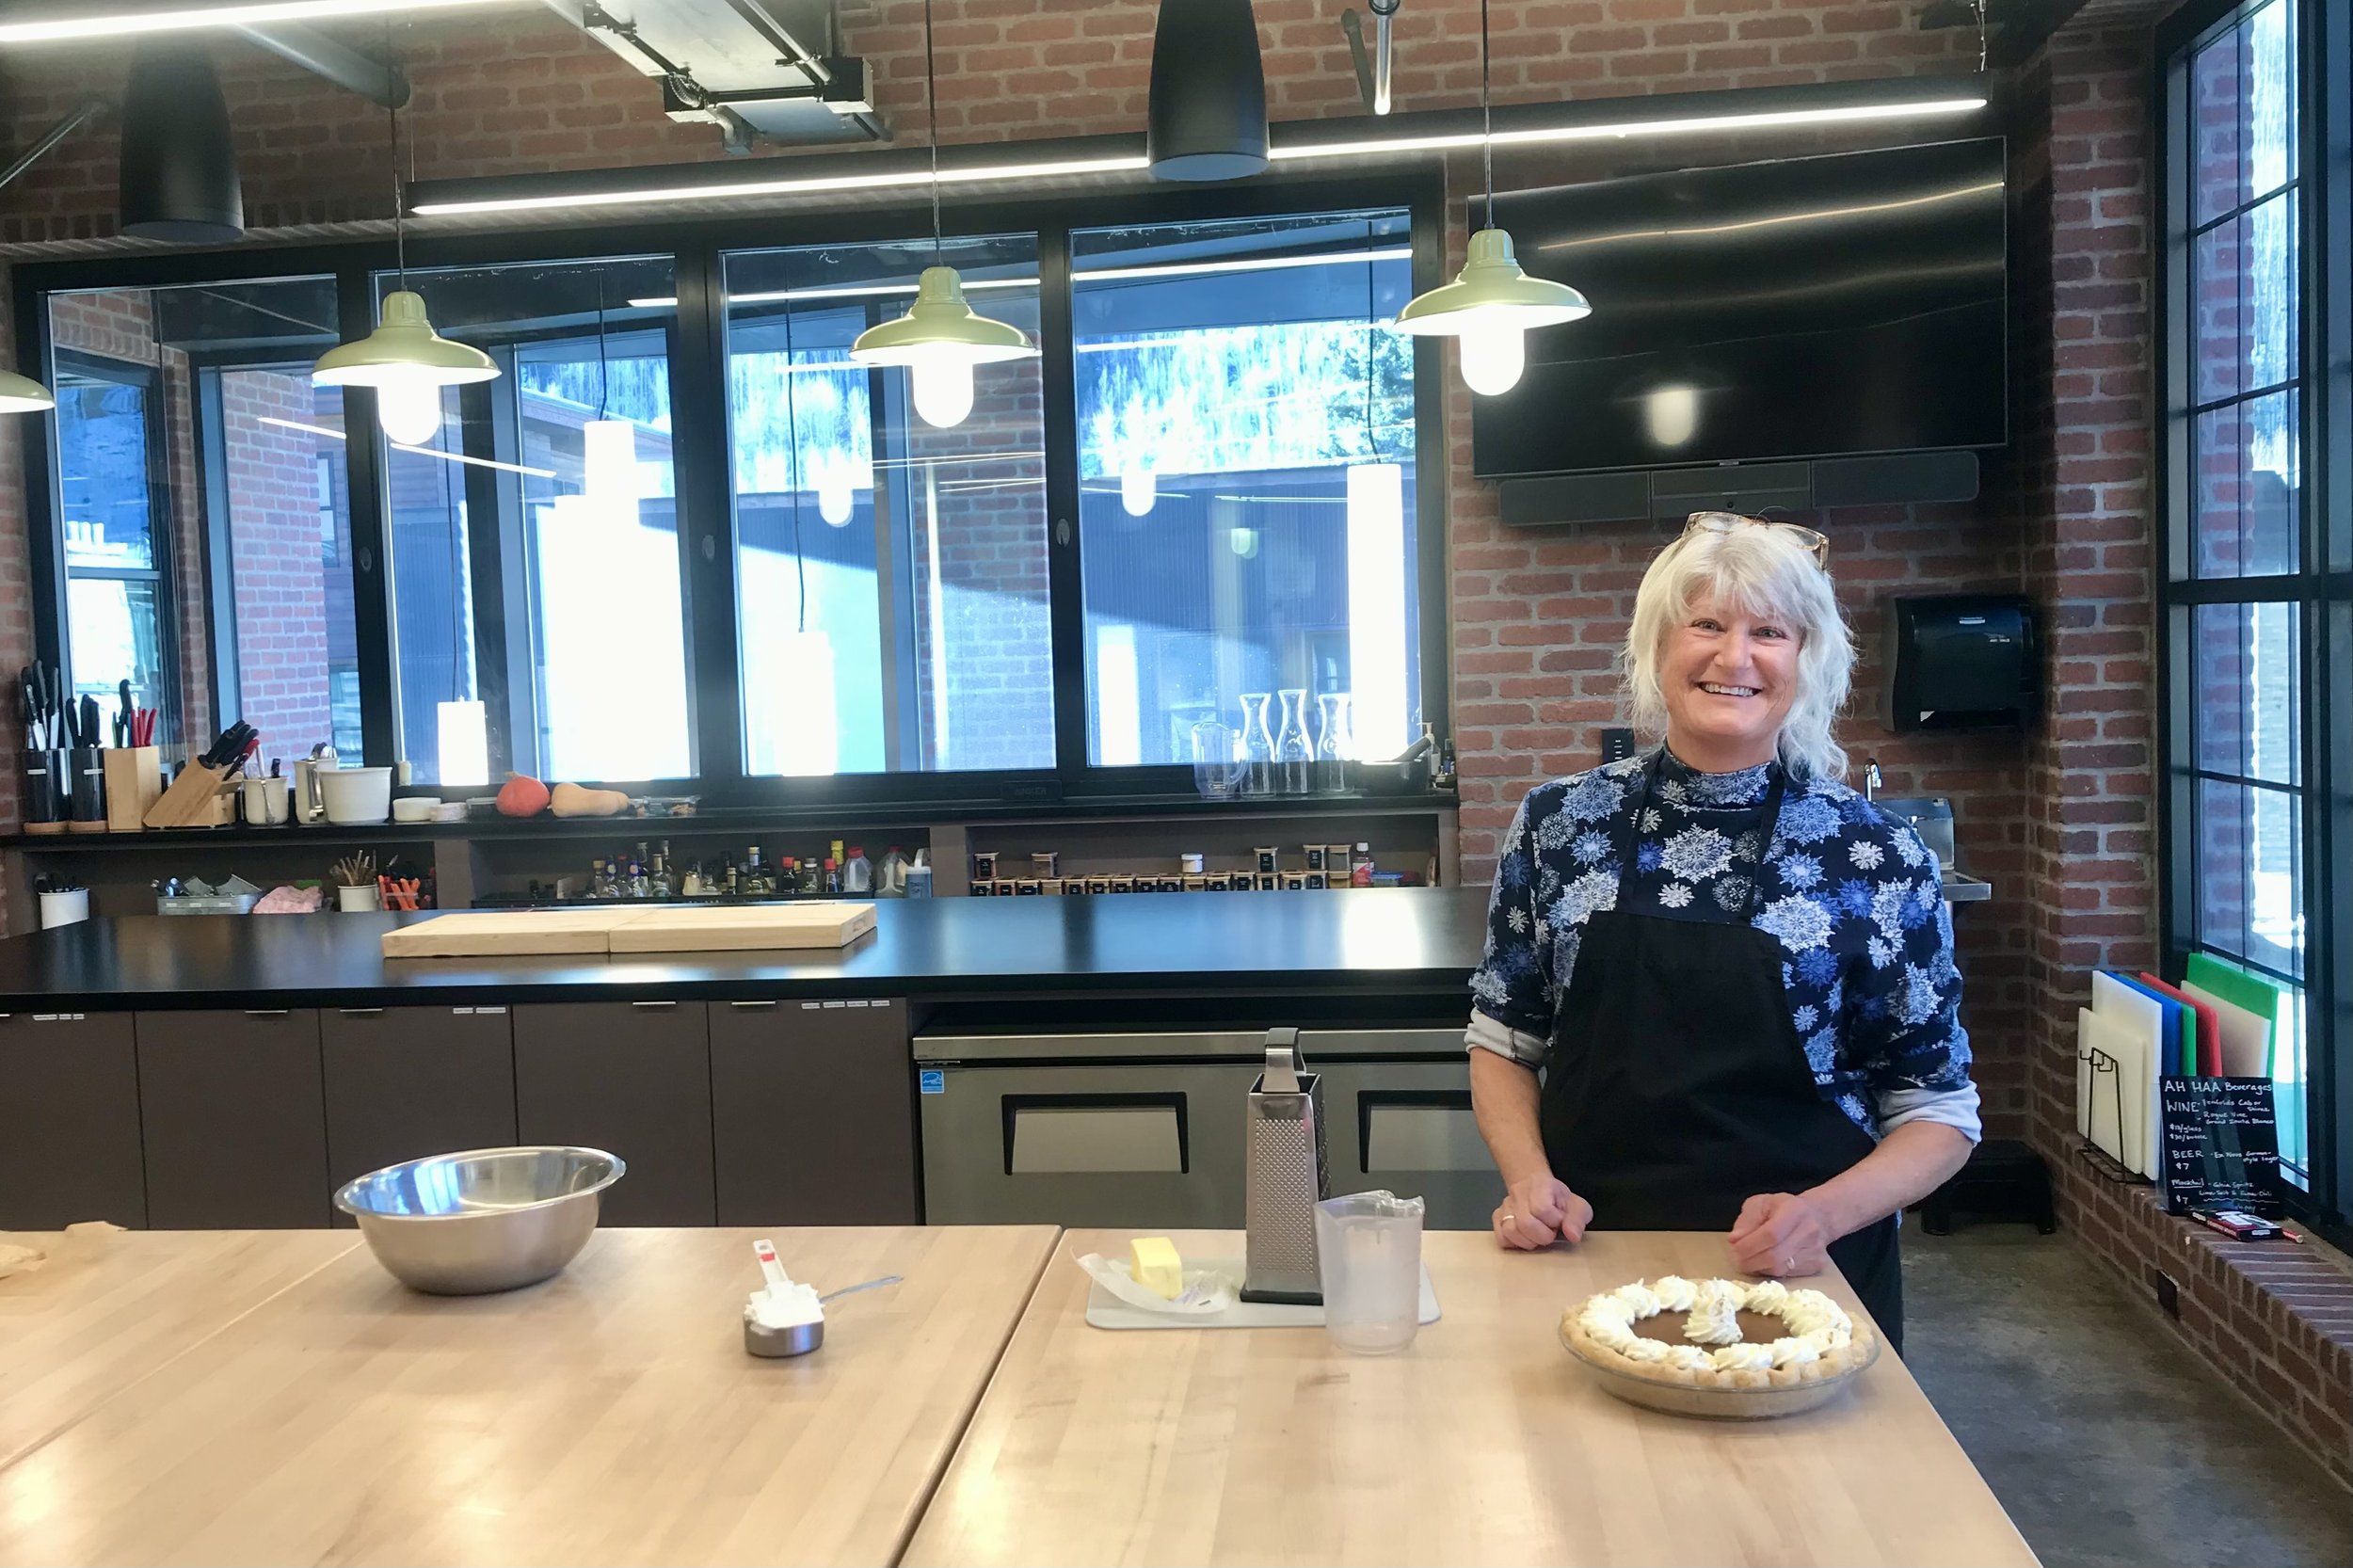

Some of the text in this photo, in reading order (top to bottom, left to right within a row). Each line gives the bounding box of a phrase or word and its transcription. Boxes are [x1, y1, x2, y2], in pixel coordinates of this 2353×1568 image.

[2165, 1080, 2272, 1095] AH HAA Beverages
[2167, 1099, 2199, 1112] WINE
[2172, 1150, 2204, 1159] BEER
